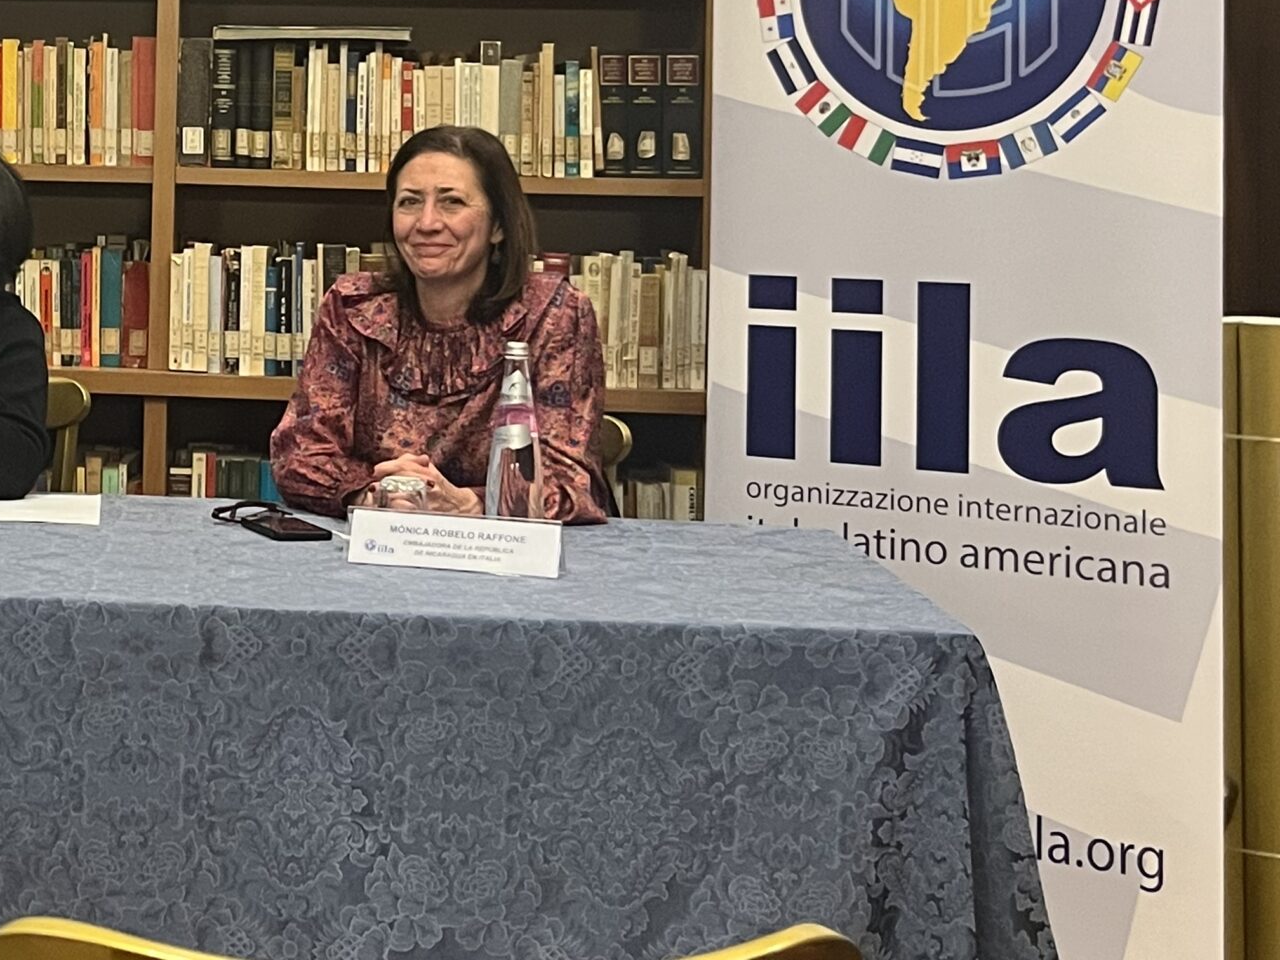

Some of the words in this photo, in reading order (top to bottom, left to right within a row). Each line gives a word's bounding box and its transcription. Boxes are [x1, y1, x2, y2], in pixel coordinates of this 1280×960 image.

[746, 274, 1165, 491] iila
[746, 480, 949, 516] organizzazione
[957, 493, 1167, 536] internazionale
[432, 527, 475, 540] ROBELO
[477, 531, 527, 545] RAFFONE
[452, 542, 463, 550] DE
[463, 543, 474, 551] LA
[413, 549, 425, 557] DE
[425, 550, 466, 560] NICARAGUA
[959, 541, 1171, 589] americana
